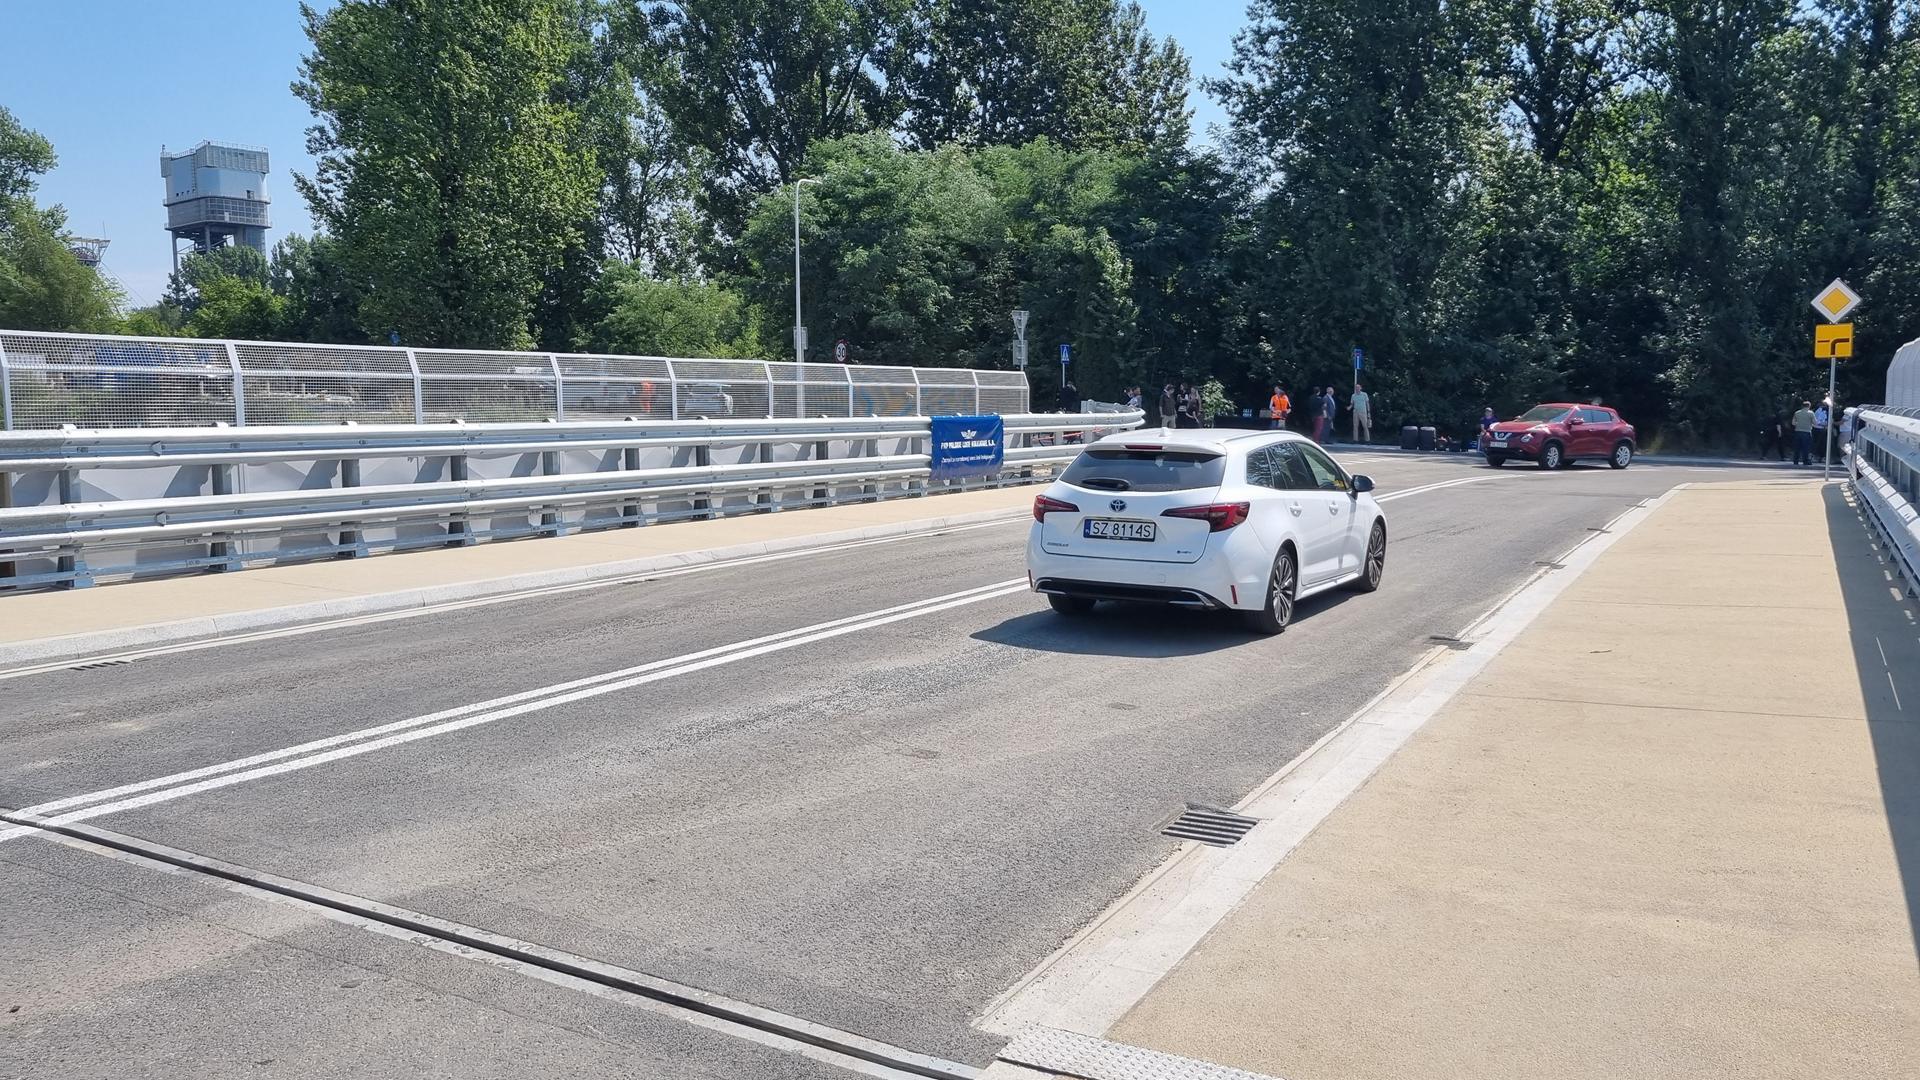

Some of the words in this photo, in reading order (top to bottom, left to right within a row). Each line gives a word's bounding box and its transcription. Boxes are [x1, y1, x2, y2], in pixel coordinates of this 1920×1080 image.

[838, 347, 845, 358] 30
[1093, 522, 1108, 535] SZ
[1112, 523, 1151, 537] 8114S
